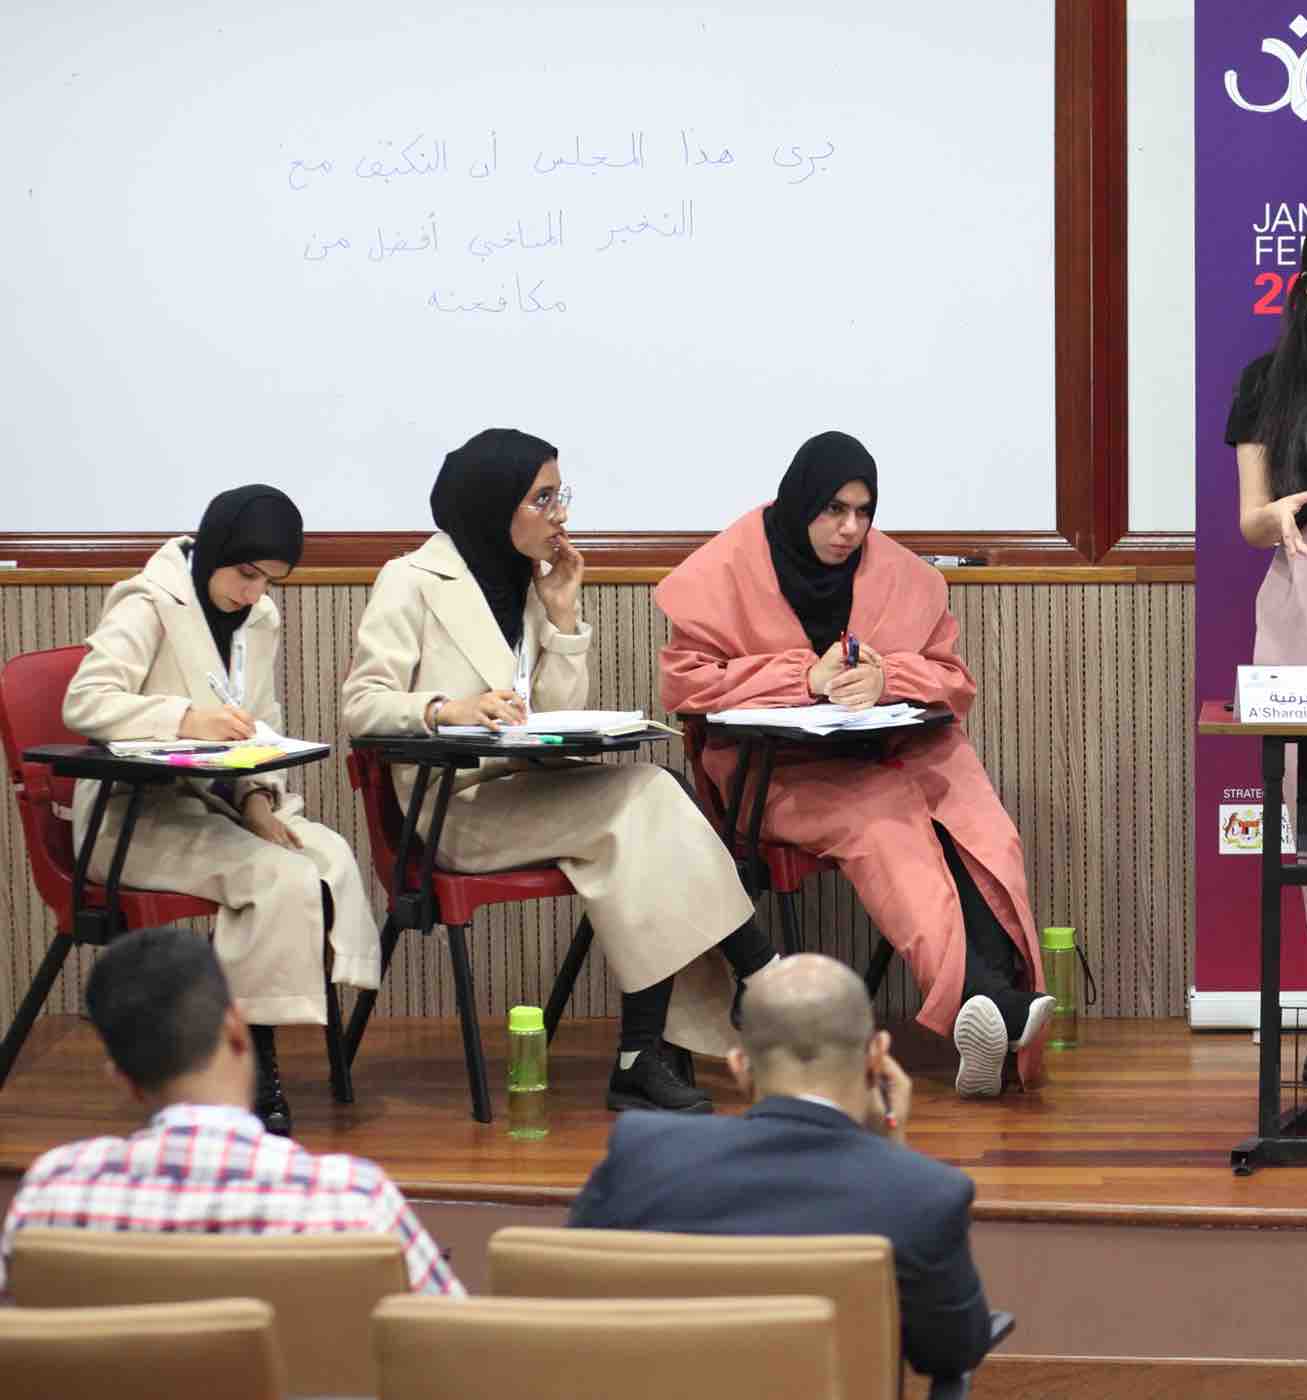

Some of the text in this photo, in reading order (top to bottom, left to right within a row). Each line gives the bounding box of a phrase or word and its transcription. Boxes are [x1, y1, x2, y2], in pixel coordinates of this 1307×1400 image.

[469, 130, 498, 179] أن
[533, 130, 647, 176] المجلس
[681, 128, 736, 168] هذا
[772, 136, 836, 184] يرى
[303, 231, 351, 262] من
[367, 210, 439, 262] أفضل
[1223, 788, 1265, 799] STRATE
